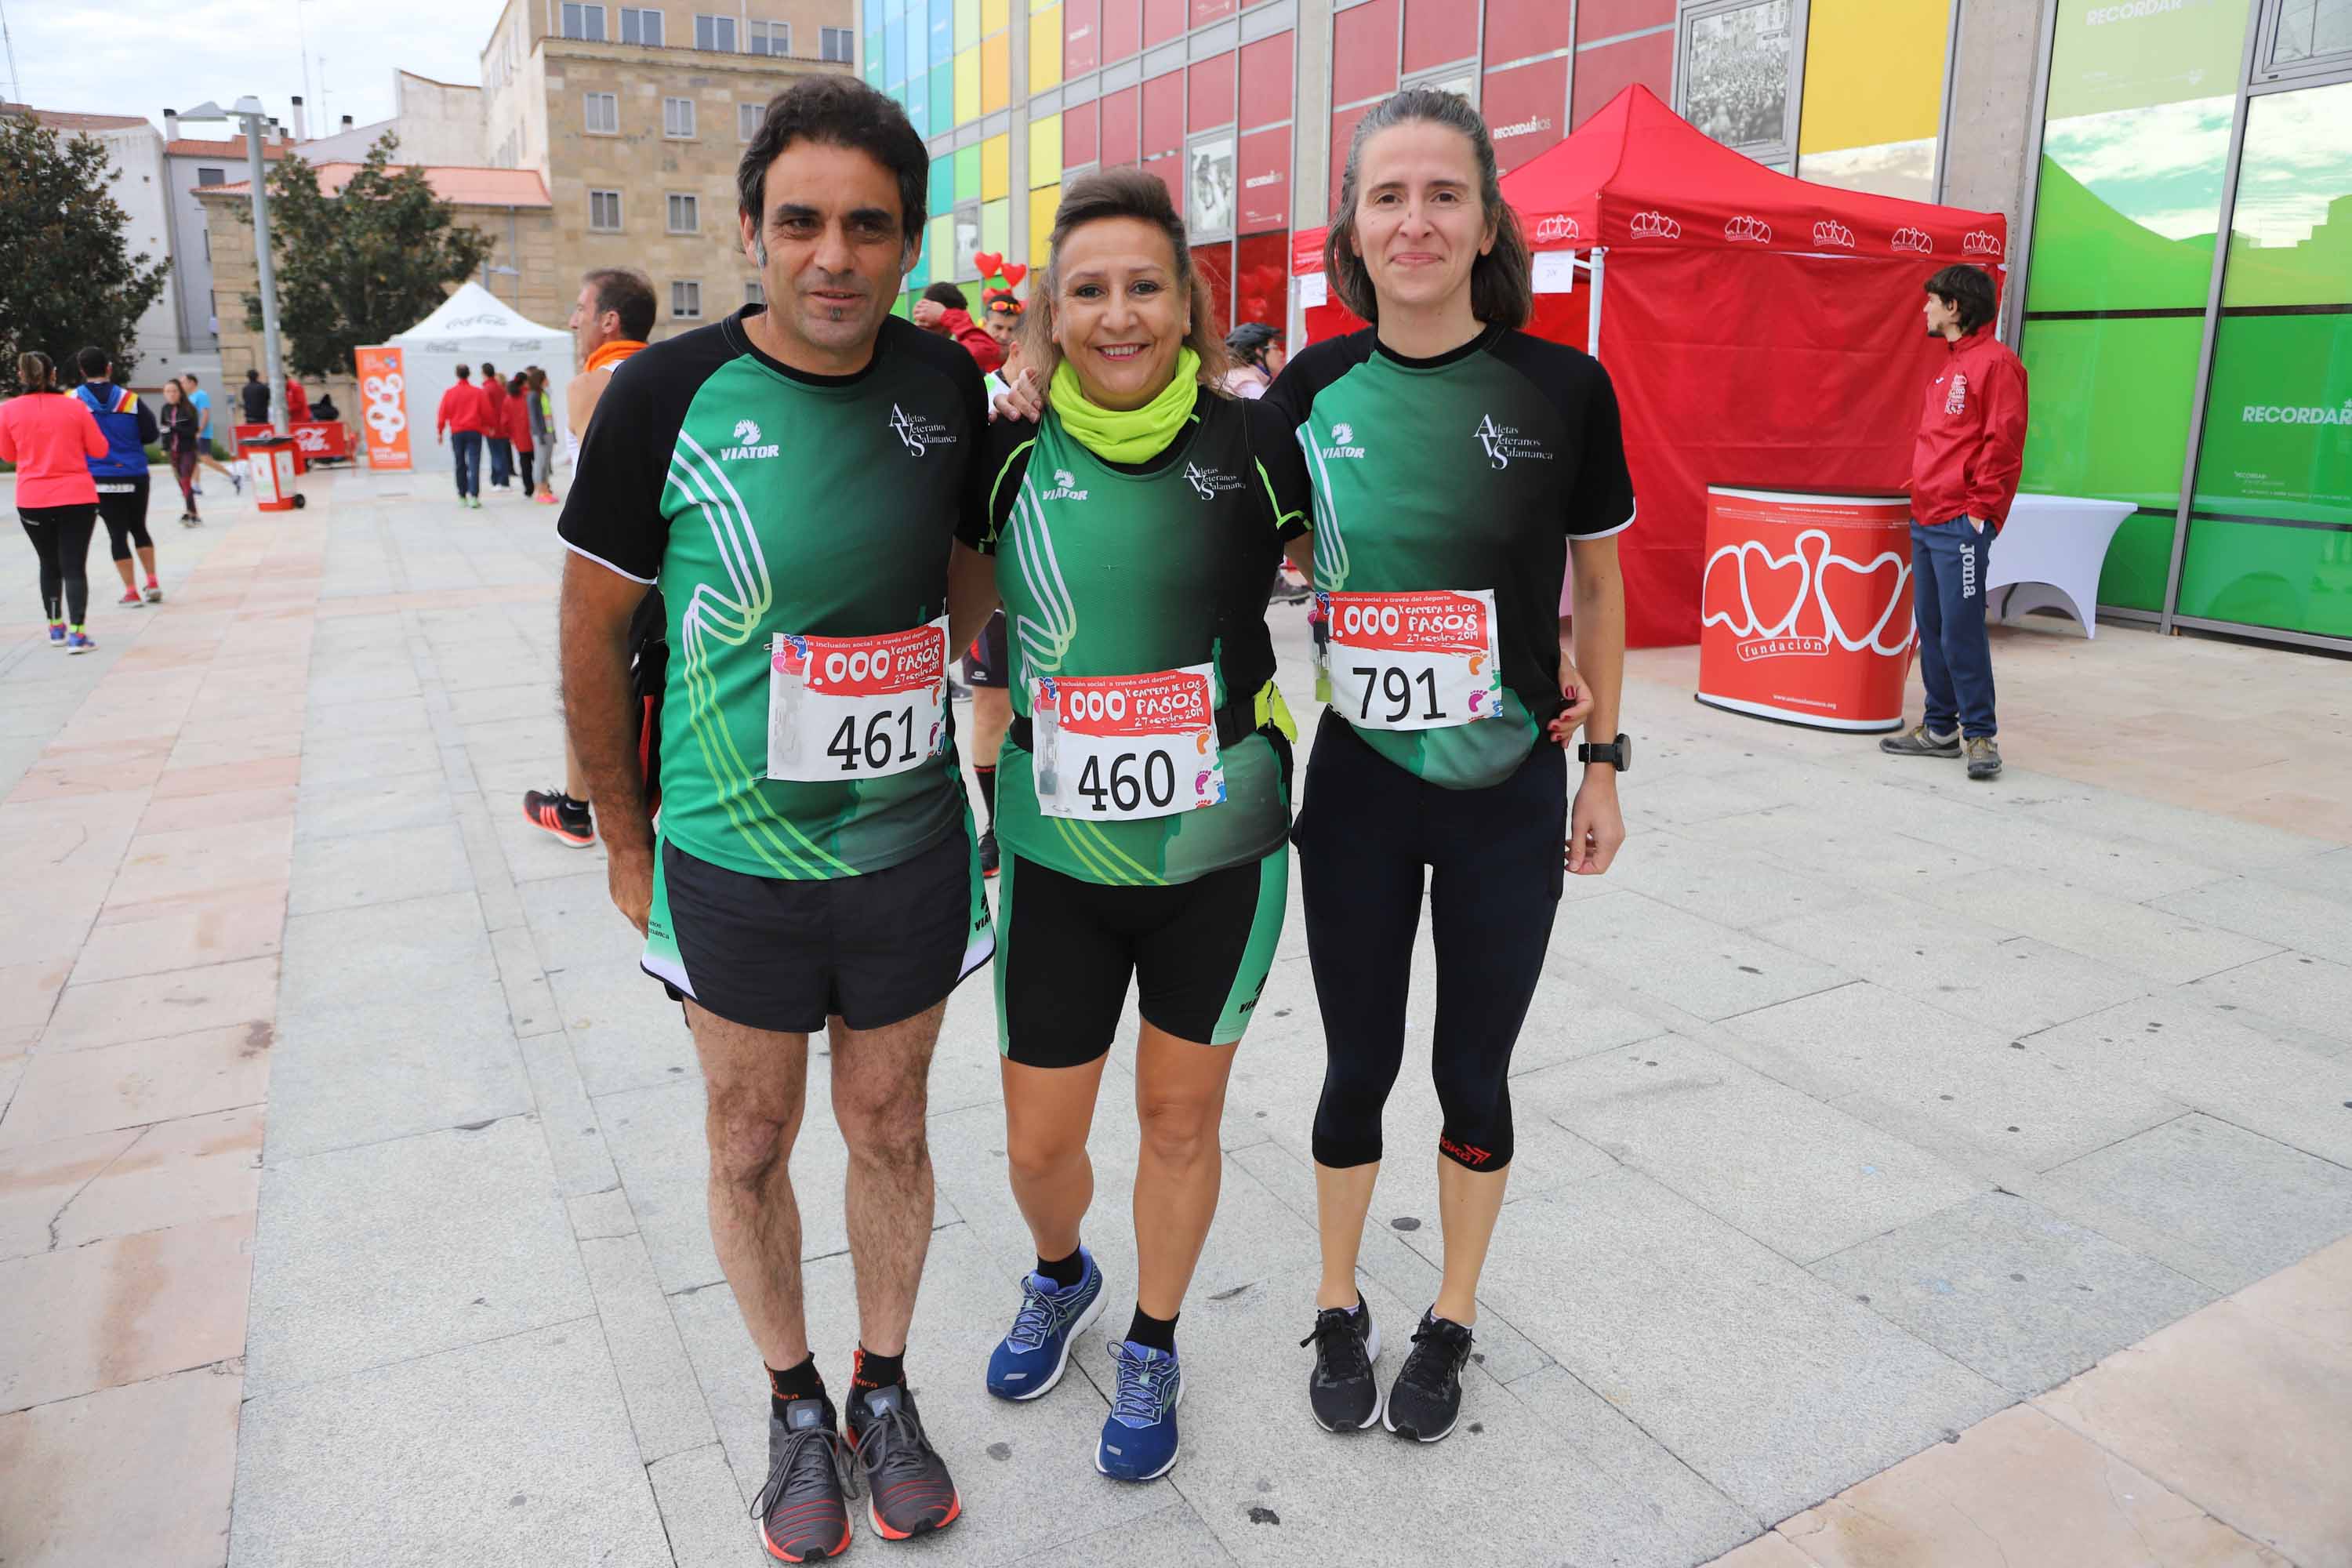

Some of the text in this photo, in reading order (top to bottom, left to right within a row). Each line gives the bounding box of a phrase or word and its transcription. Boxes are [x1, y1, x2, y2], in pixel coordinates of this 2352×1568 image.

[1473, 414, 1519, 437] Atletas
[720, 445, 779, 461] VIATOR
[909, 434, 956, 457] Salamanca
[1322, 447, 1366, 459] VIATOR
[1479, 434, 1541, 458] Veteranos
[1491, 445, 1553, 470] Salamanca
[1182, 461, 1218, 478] Atletas
[1189, 475, 1237, 492] Veteranos
[1042, 489, 1089, 501] VIATOR
[1959, 543, 1976, 598] Joma
[1457, 604, 1477, 612] LOS
[1408, 614, 1478, 633] PASOS
[1406, 634, 1419, 643] 27
[1457, 631, 1479, 641] 2019
[1744, 639, 1822, 657] fundación
[802, 649, 891, 686] 1.000
[898, 644, 940, 672] PASOS
[1182, 680, 1200, 691] LOS
[1352, 666, 1446, 722] 791
[1136, 691, 1201, 715] PASOS
[1134, 717, 1148, 728] 27
[1185, 707, 1204, 720] 2019
[827, 706, 916, 771] 461
[1078, 750, 1175, 811] 460
